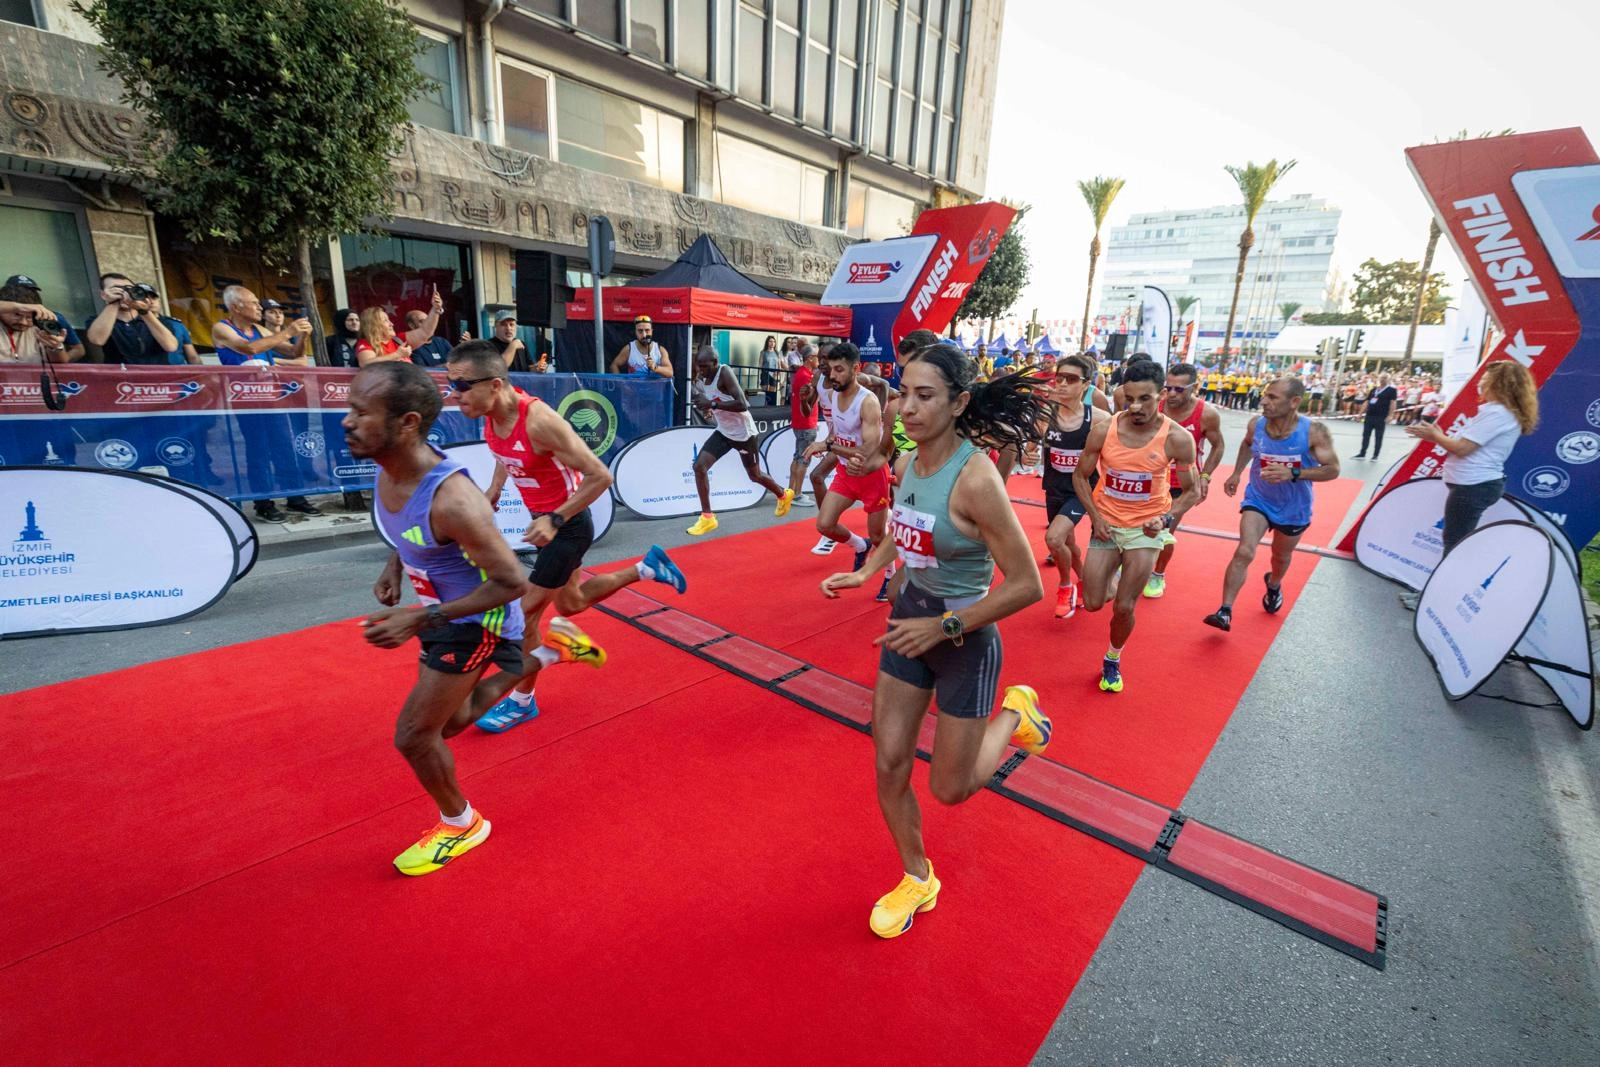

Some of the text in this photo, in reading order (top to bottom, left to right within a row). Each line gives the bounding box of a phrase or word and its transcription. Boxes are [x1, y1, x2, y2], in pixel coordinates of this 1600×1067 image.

[1453, 193, 1549, 306] FINISH
[911, 240, 959, 322] FINISH
[941, 282, 971, 298] 21K
[1047, 430, 1062, 441] M
[1111, 477, 1143, 493] 1778
[12, 542, 52, 552] İZMİR
[0, 552, 75, 566] ÜYÜKŞEHİR
[2, 566, 72, 577] ELEDİYESİ
[0, 588, 184, 608] ZMETLERİ DAİRESİ BAŞKANLIĞI
